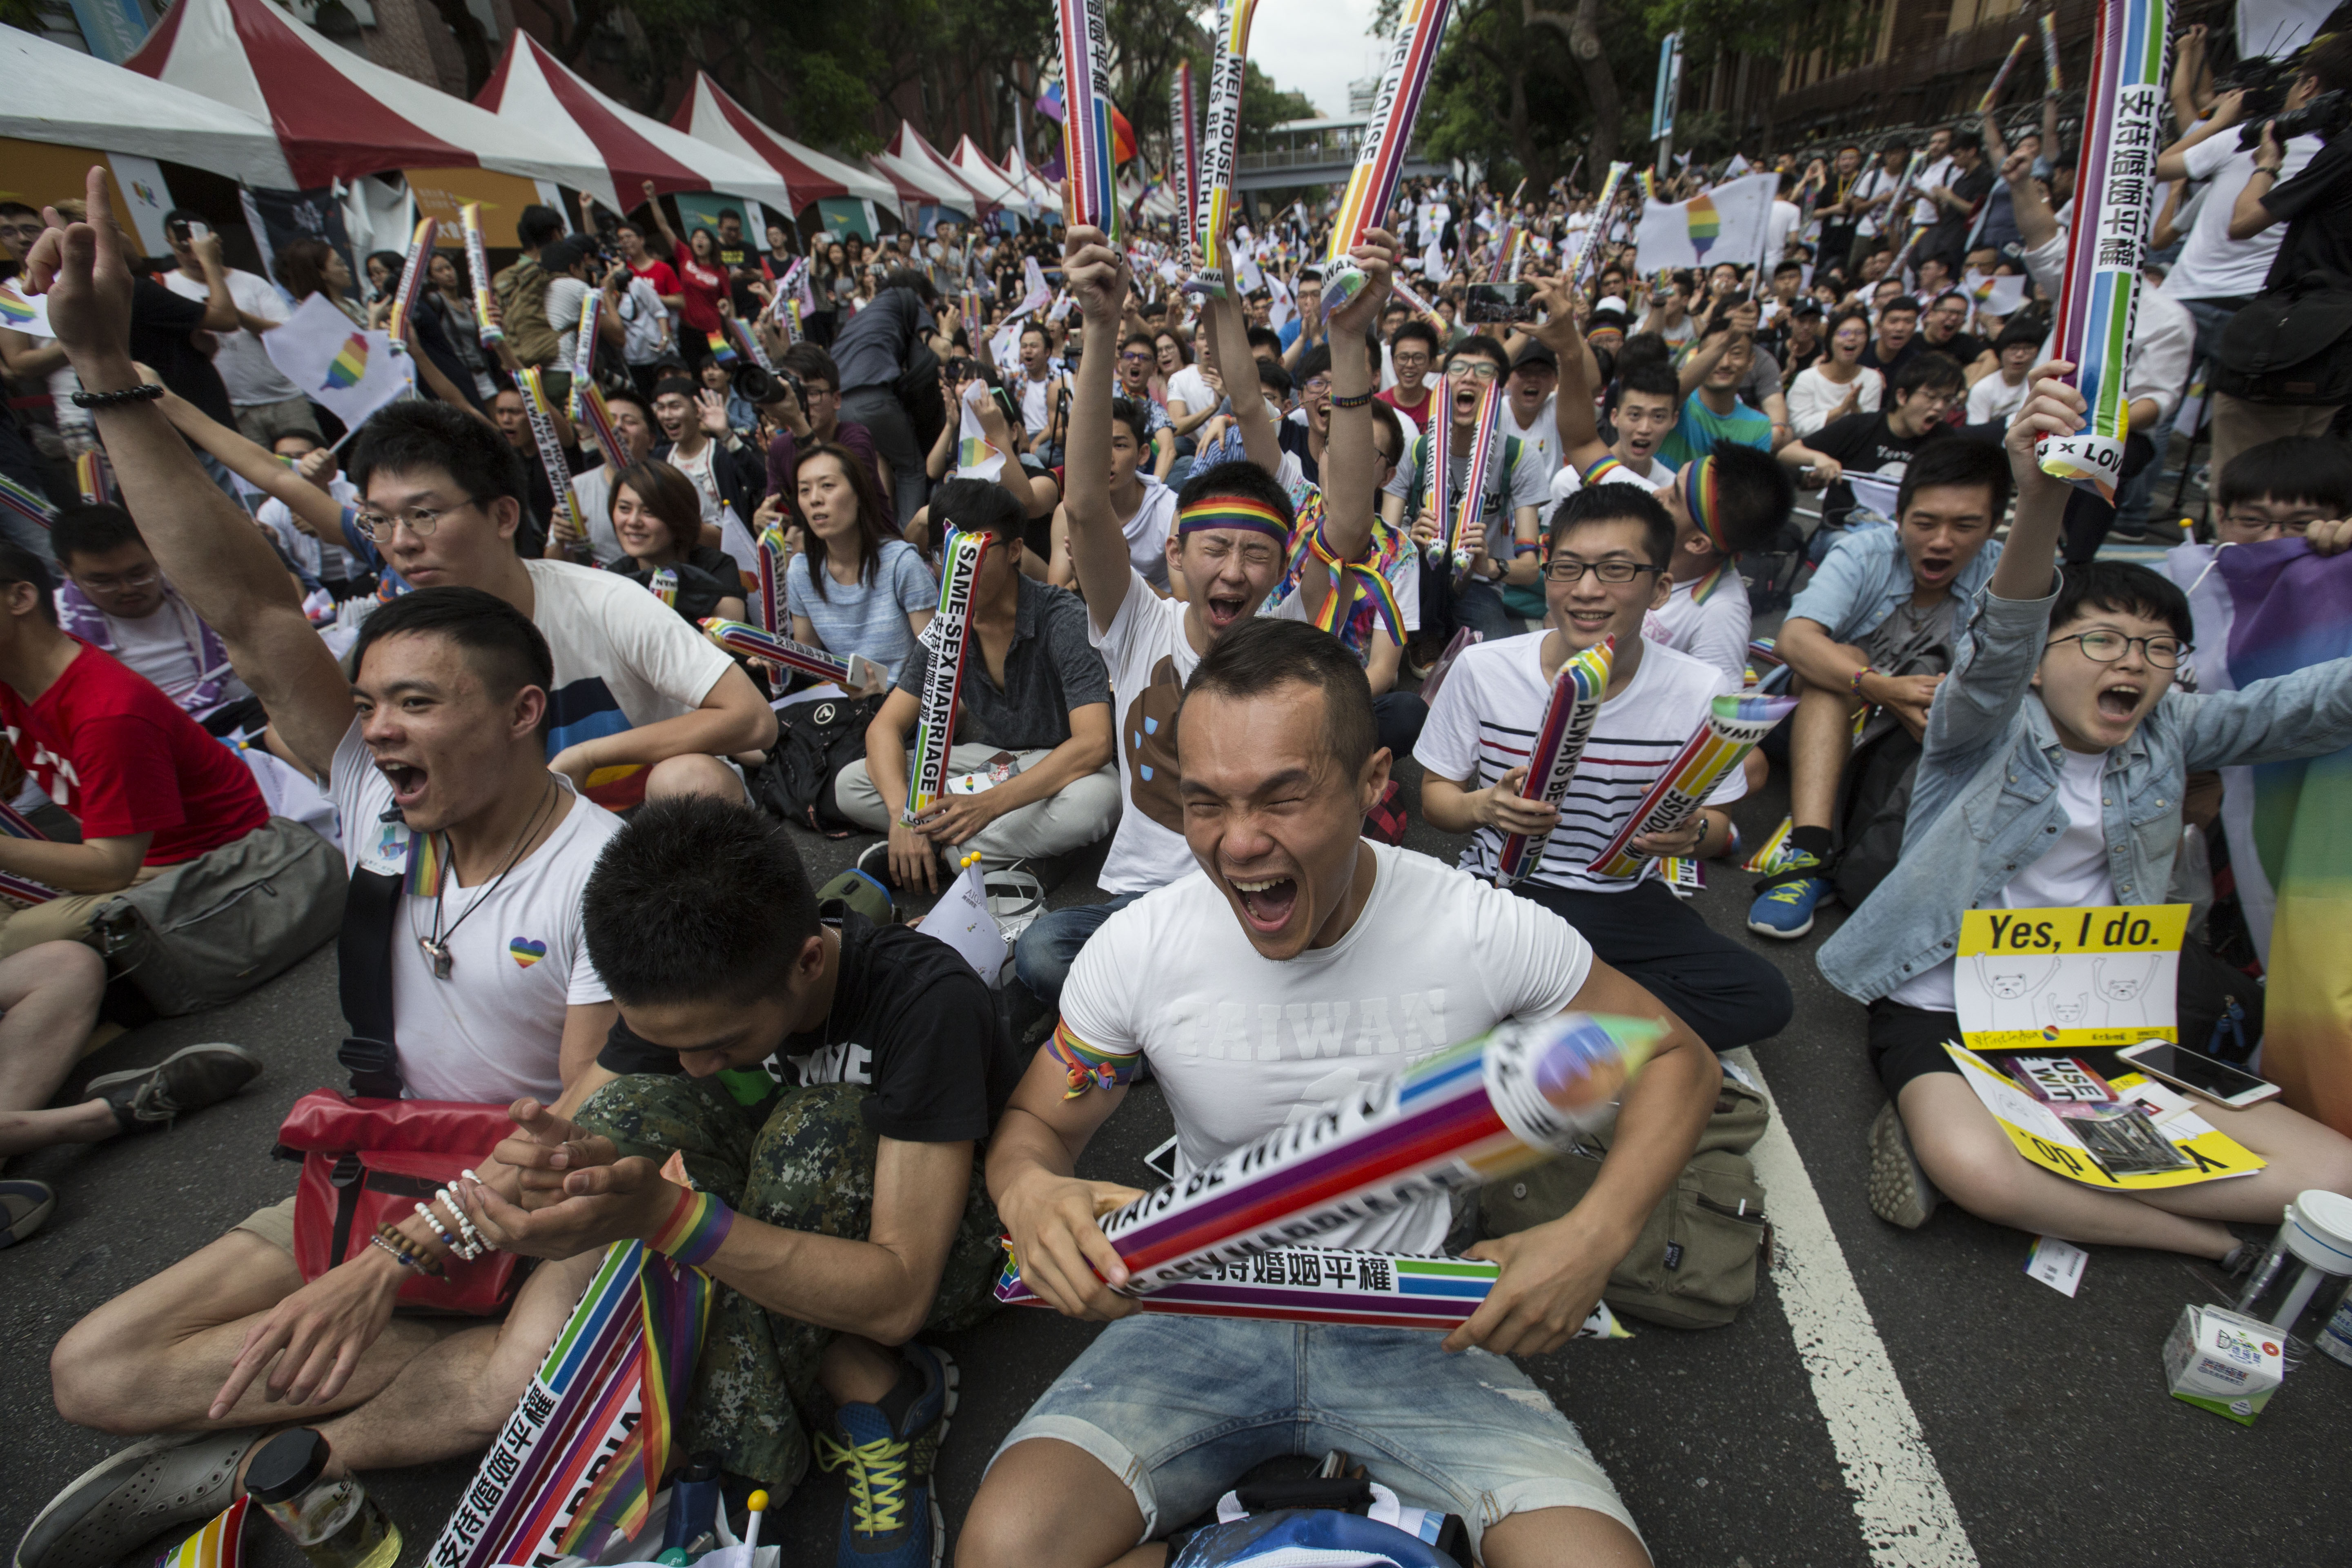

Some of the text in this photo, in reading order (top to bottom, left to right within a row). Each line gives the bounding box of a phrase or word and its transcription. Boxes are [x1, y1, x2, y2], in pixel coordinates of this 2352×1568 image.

[1198, 12, 1231, 228] ALWAYS BE WITH U
[1215, 58, 1242, 185] WEI HOUSE
[1363, 77, 1399, 160] HOUSE
[2099, 91, 2155, 267] 支持婚姻平權
[1177, 177, 1192, 272] MARRIAGE
[521, 388, 547, 444] ALWAYS
[543, 449, 555, 468] BE
[2083, 443, 2123, 472] LOV
[550, 443, 572, 491] HOUSE
[774, 554, 788, 626] ALWAYS BE
[919, 615, 944, 722] 支持婚姻平權
[920, 545, 977, 792] SAME-SEX MARRIAGE
[1546, 703, 1595, 803] ALWAYS BE
[906, 815, 929, 826] LOV
[1641, 790, 1692, 834] HOUSE
[1989, 911, 2160, 953] Yes, I do.
[1170, 988, 1448, 1061] TAIWAN
[2030, 1067, 2076, 1102] WIT
[2020, 1131, 2084, 1176] do.
[1198, 1250, 1392, 1291] 持婚姻平權
[434, 1387, 558, 1568] 支持婚姻平權
